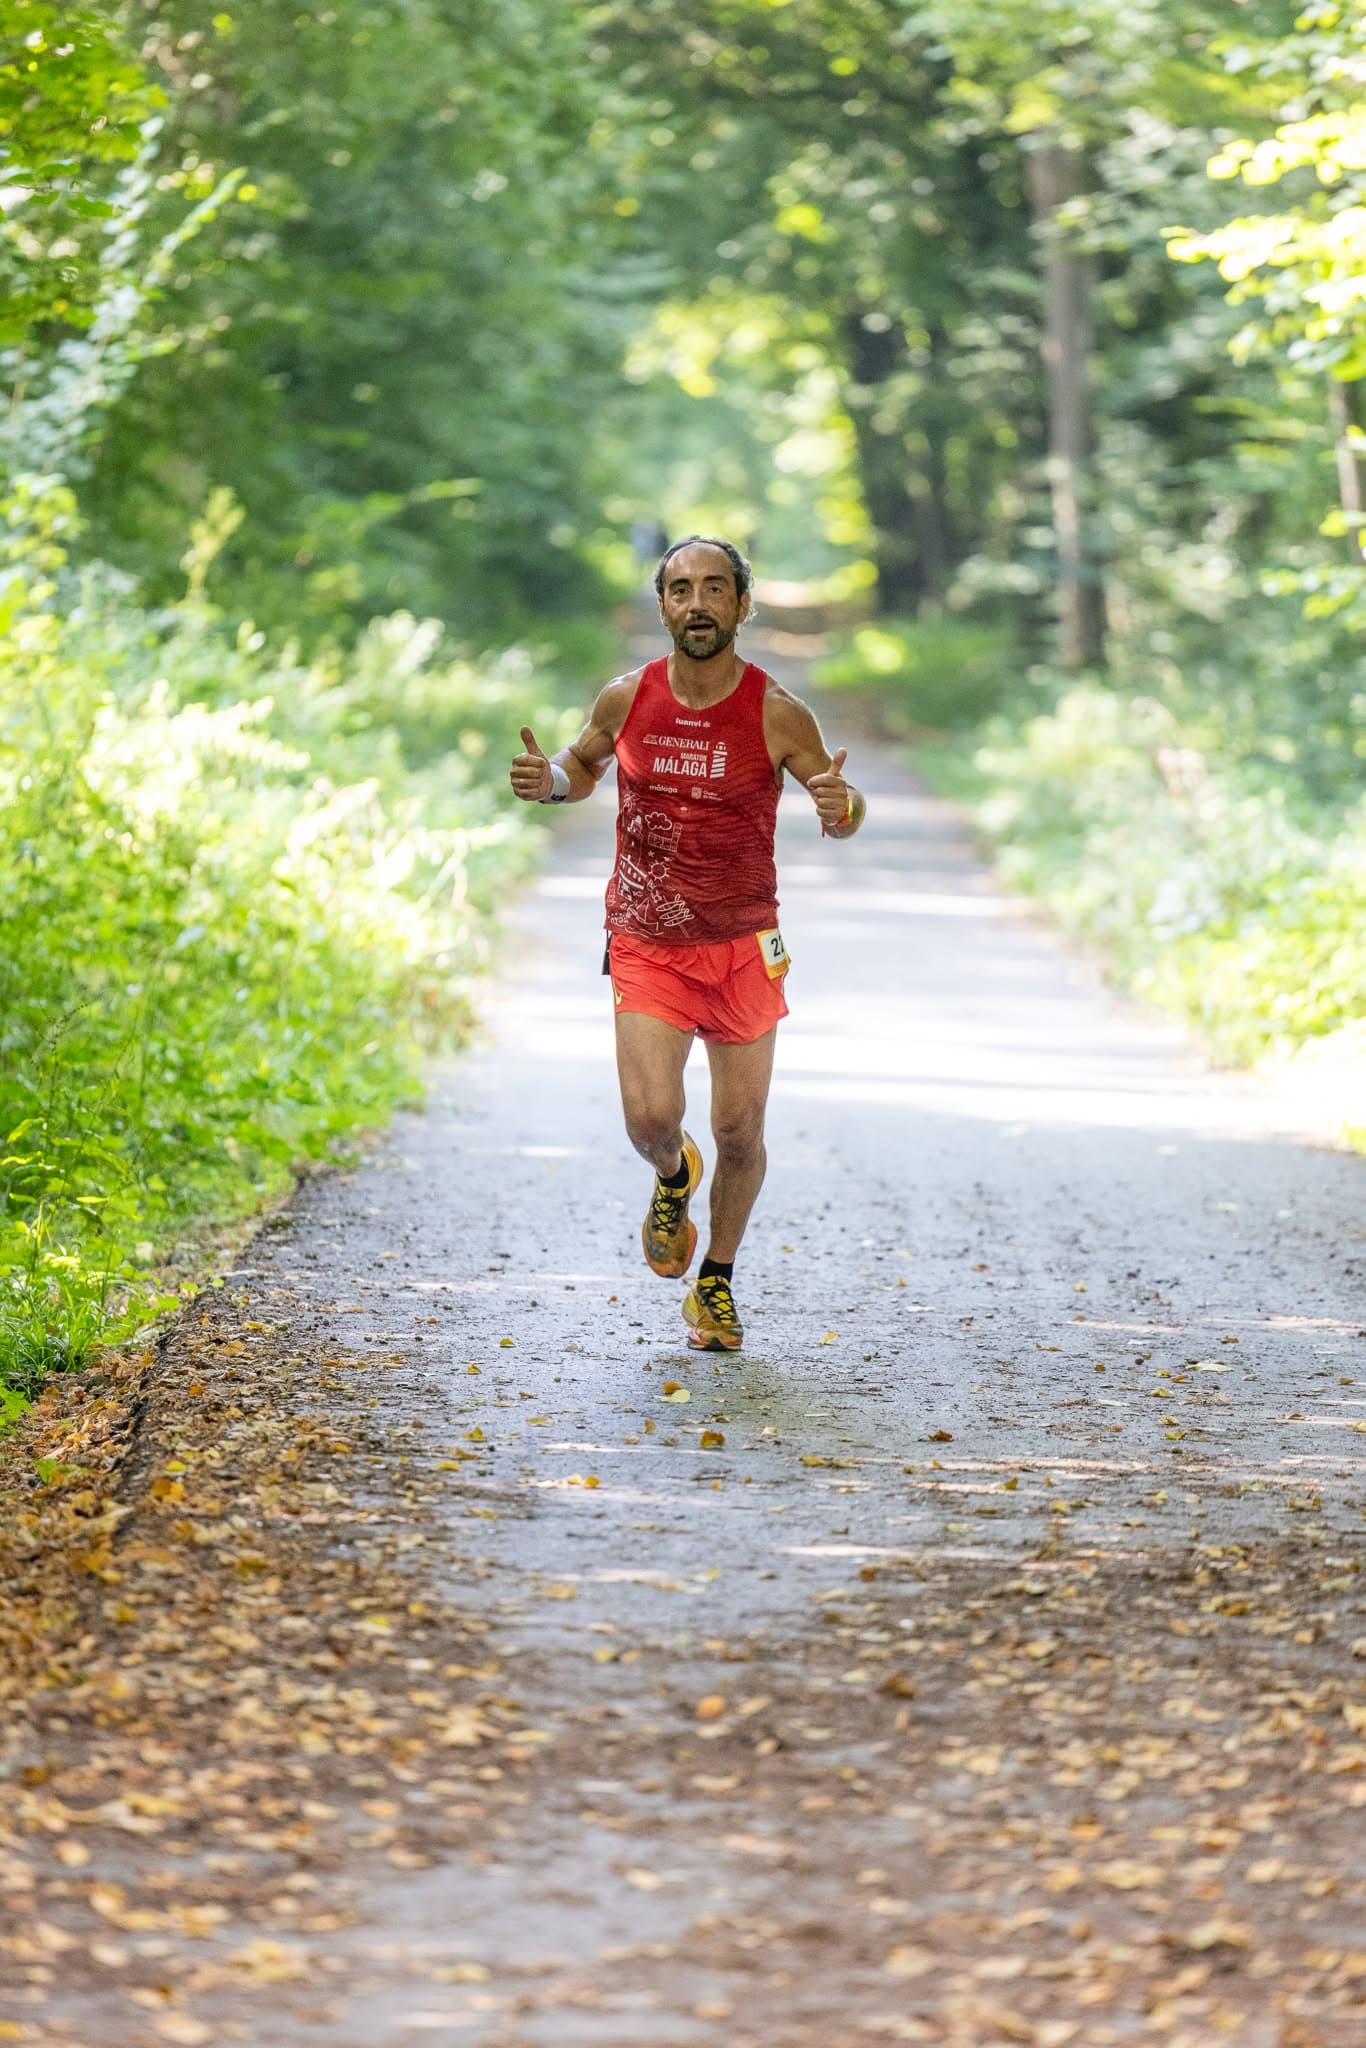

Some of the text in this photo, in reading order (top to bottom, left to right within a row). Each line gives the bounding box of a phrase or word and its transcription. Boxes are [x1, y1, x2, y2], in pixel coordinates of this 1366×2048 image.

[658, 735, 710, 751] GENERALI
[652, 756, 707, 778] MÁLAGA
[649, 784, 678, 794] málaga
